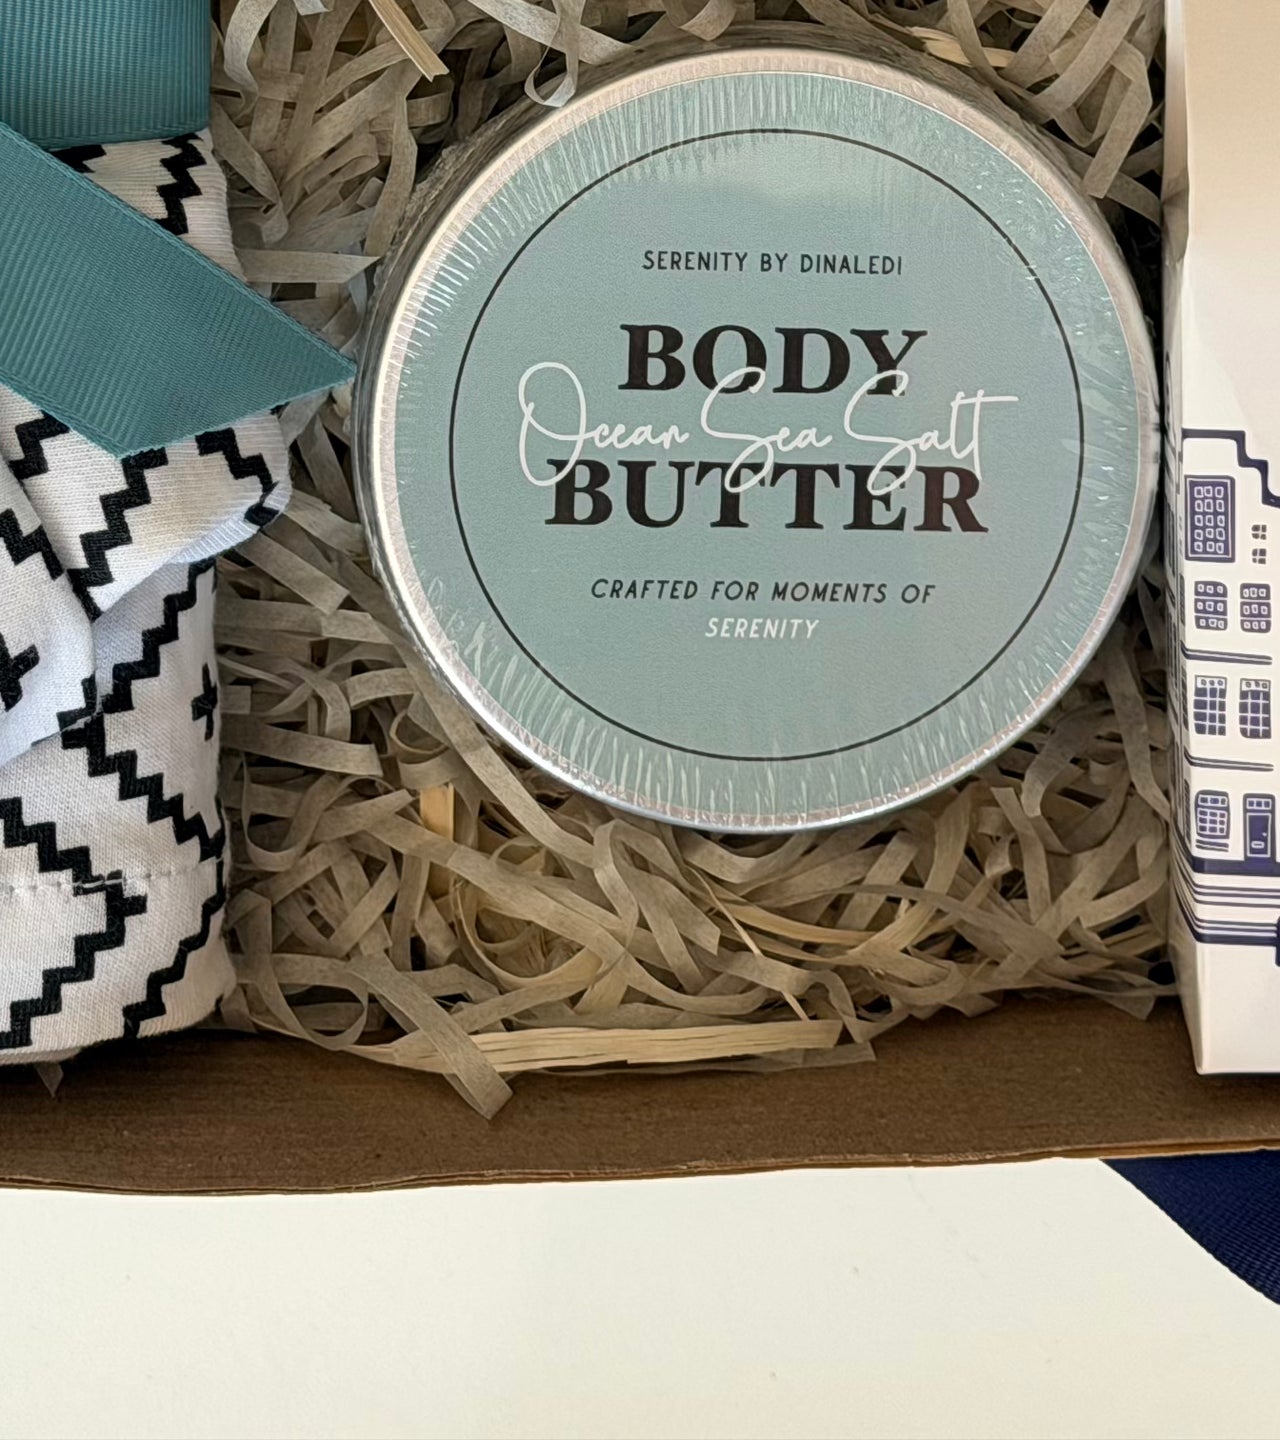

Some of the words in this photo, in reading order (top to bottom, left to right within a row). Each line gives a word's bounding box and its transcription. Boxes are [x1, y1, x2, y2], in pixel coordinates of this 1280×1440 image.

[642, 250, 748, 271] SERENITY
[760, 252, 788, 272] BY
[800, 254, 902, 275] DINALEDI
[618, 324, 928, 396] BODY
[519, 361, 689, 487] Ocean
[701, 366, 832, 493] Sea
[844, 369, 1019, 496] Salt
[544, 458, 989, 533] BUTTER
[590, 578, 698, 600] CRAFTED
[710, 580, 759, 601] FOR
[771, 581, 887, 603] MOMENTS
[900, 583, 936, 604] OF
[704, 617, 819, 639] SERENITY
